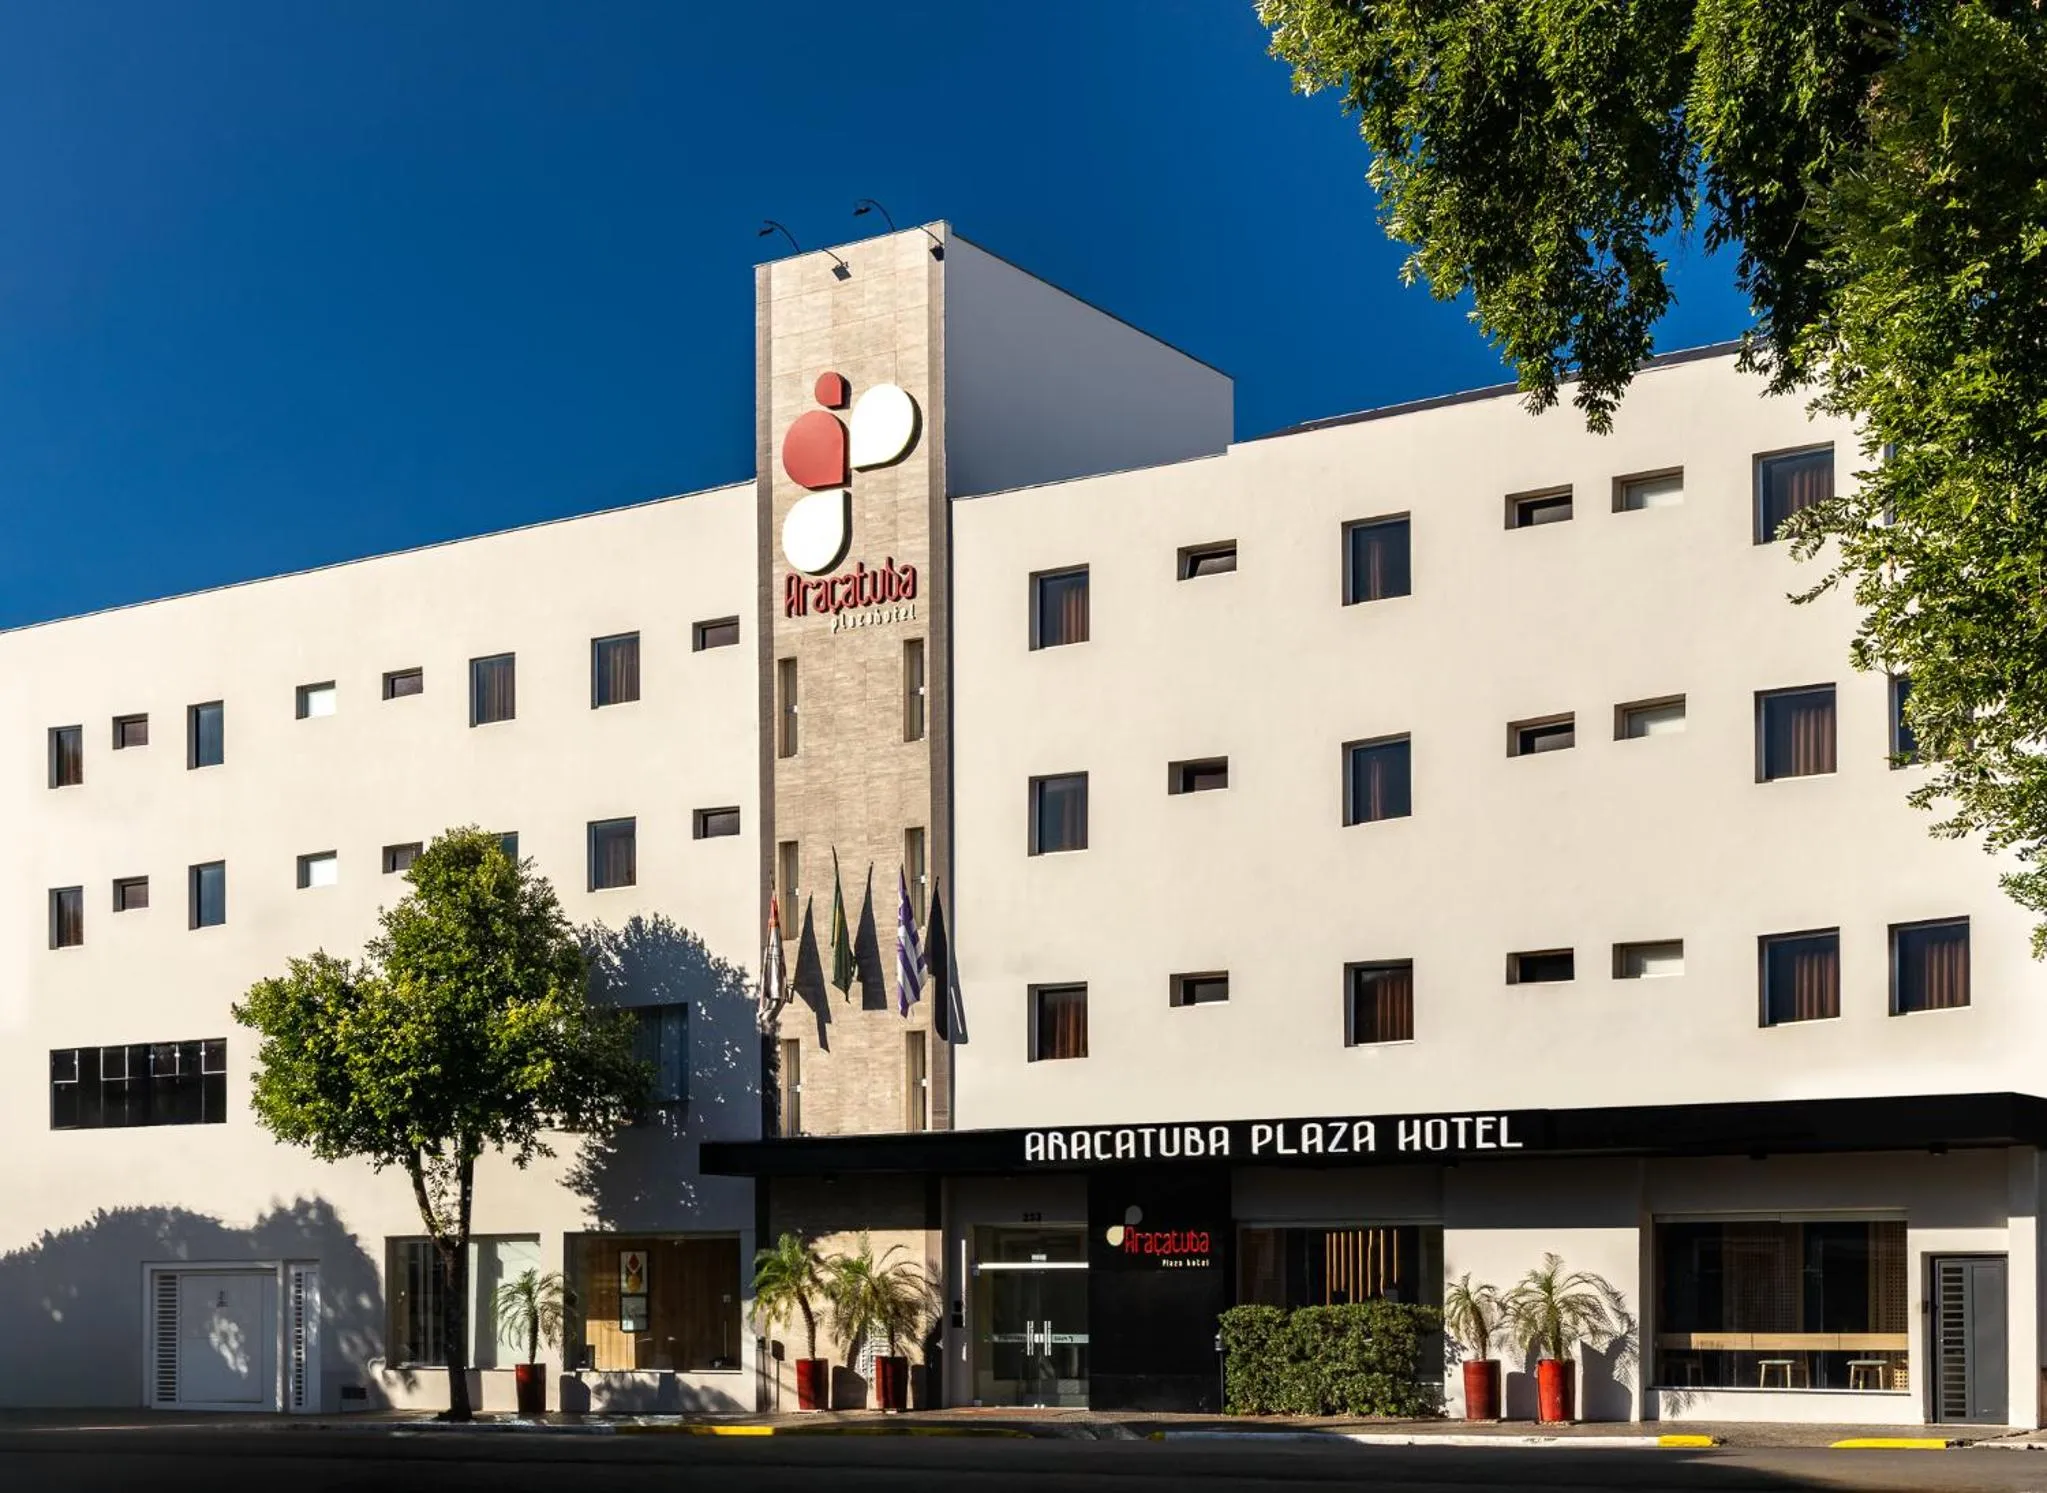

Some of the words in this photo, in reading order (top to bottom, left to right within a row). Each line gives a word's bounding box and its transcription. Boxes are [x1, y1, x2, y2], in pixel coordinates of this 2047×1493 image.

[784, 556, 918, 618] Araçatuba
[1251, 1121, 1376, 1155] PLAZA
[1398, 1115, 1524, 1151] HOTEL
[1124, 1226, 1210, 1256] Araçatuba
